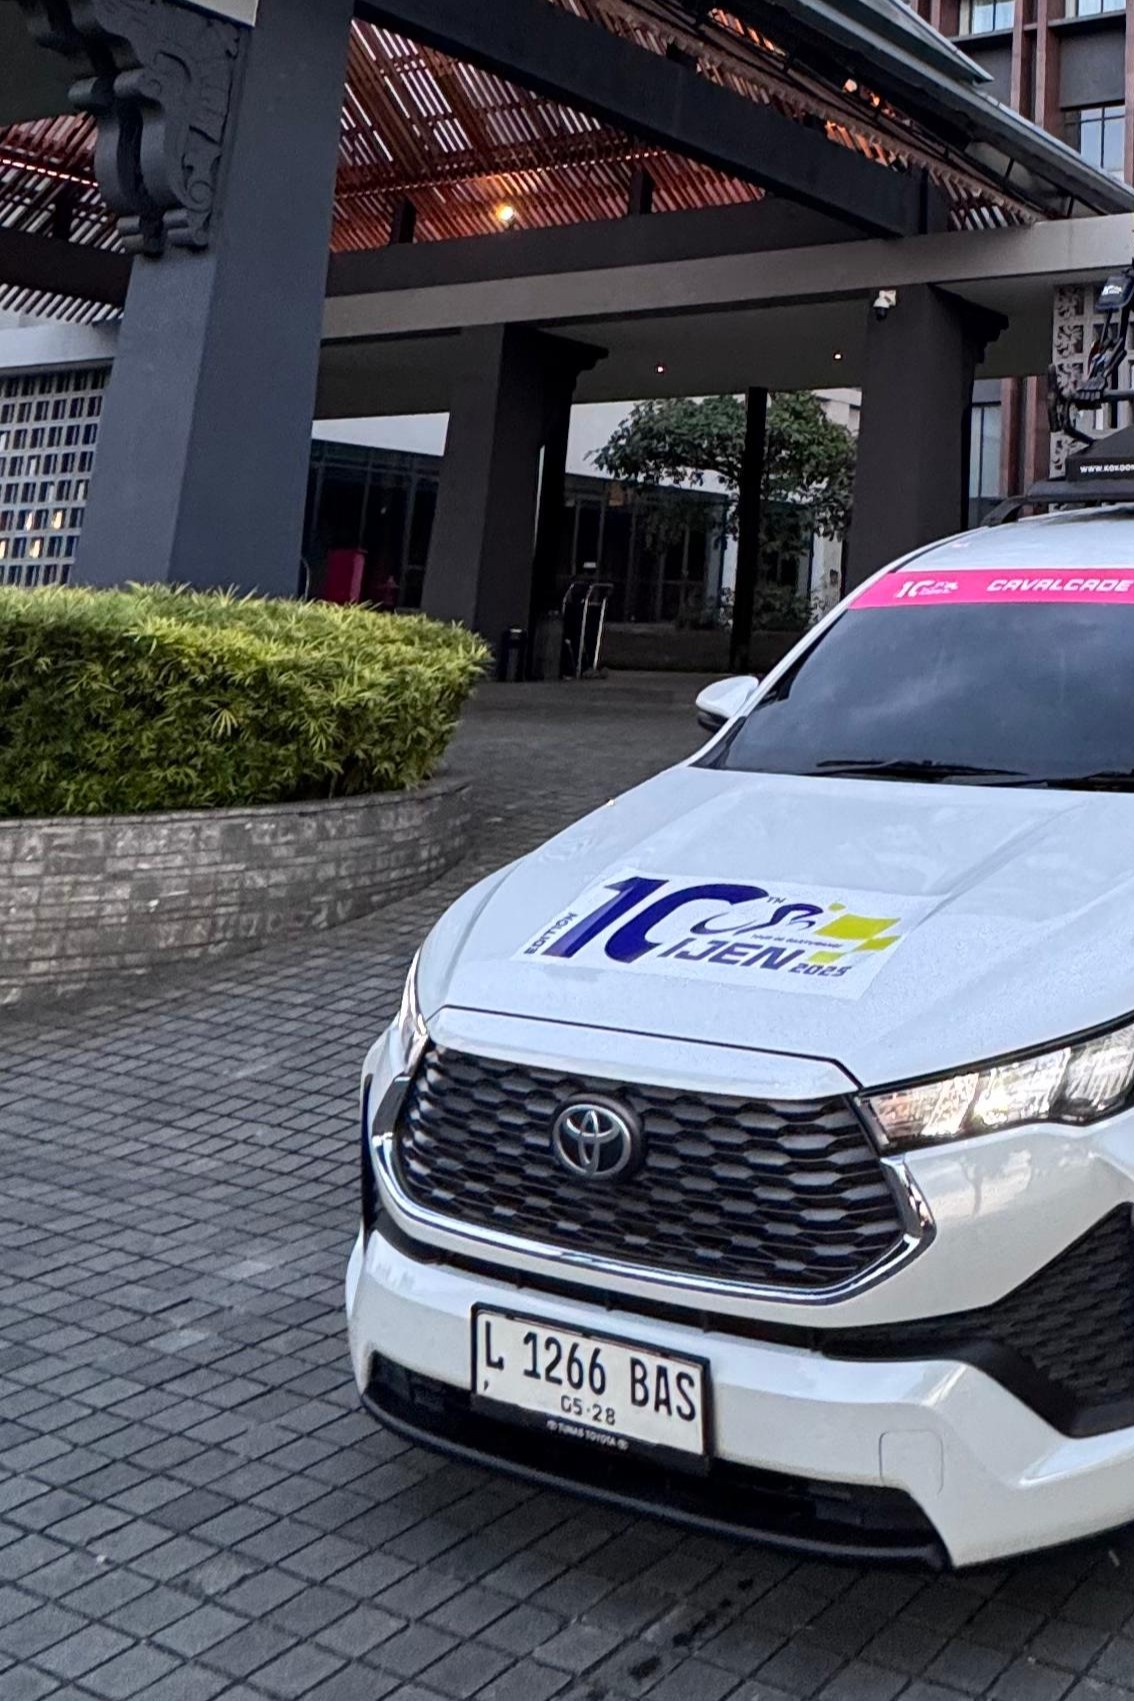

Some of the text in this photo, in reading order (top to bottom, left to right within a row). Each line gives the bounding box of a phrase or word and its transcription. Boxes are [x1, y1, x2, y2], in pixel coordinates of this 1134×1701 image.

[986, 579, 1134, 592] CAVALCADE
[525, 912, 577, 955] EDITION
[657, 937, 805, 971] IJEN
[788, 961, 853, 978] 2025
[484, 1321, 696, 1422] L 1266 BAS
